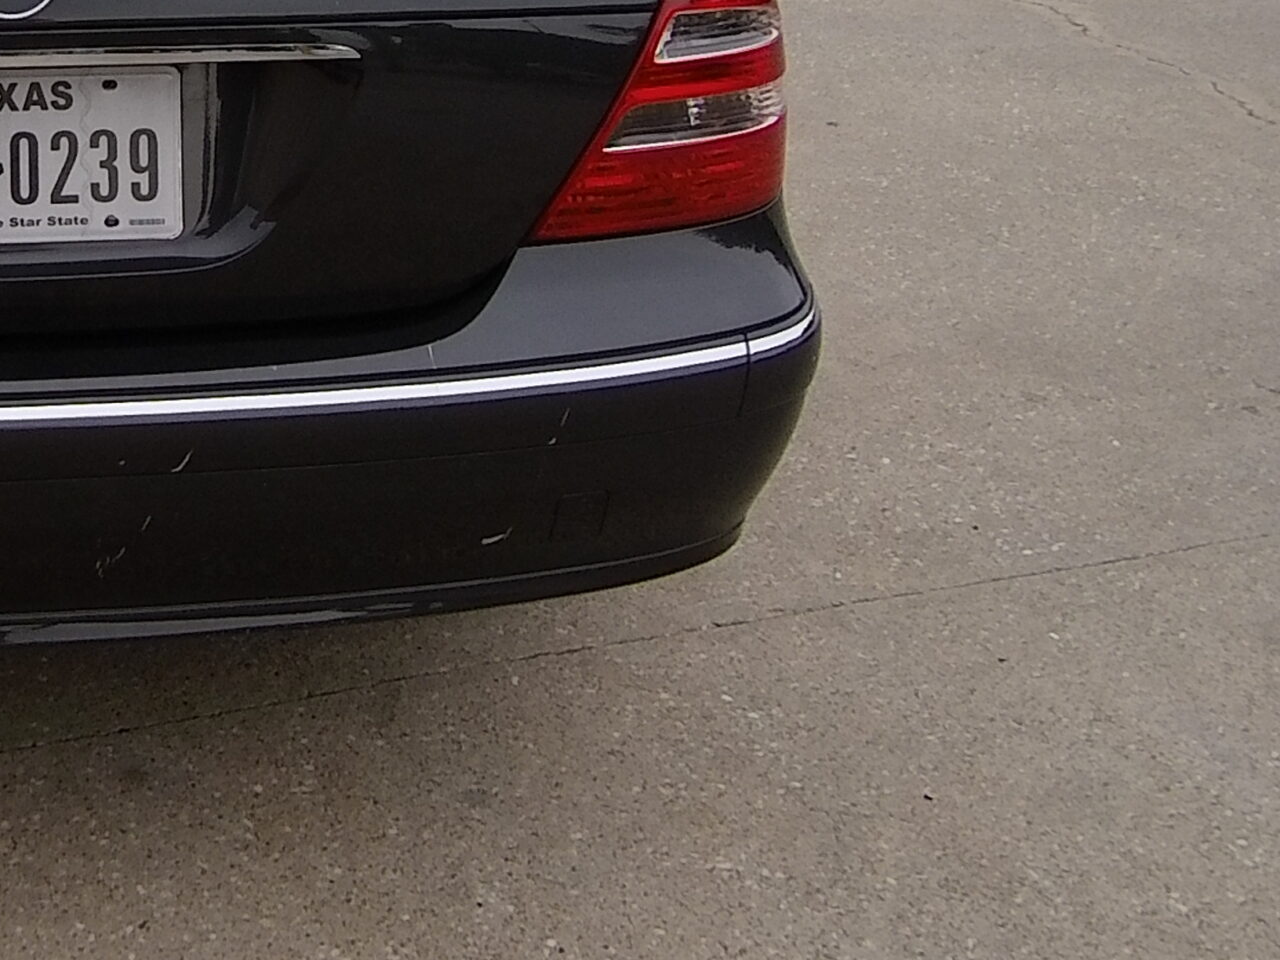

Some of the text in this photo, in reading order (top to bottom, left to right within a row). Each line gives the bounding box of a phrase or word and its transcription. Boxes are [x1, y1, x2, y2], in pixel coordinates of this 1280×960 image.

[9, 128, 159, 205] 0239
[9, 216, 42, 228] Star
[47, 215, 89, 227] State
